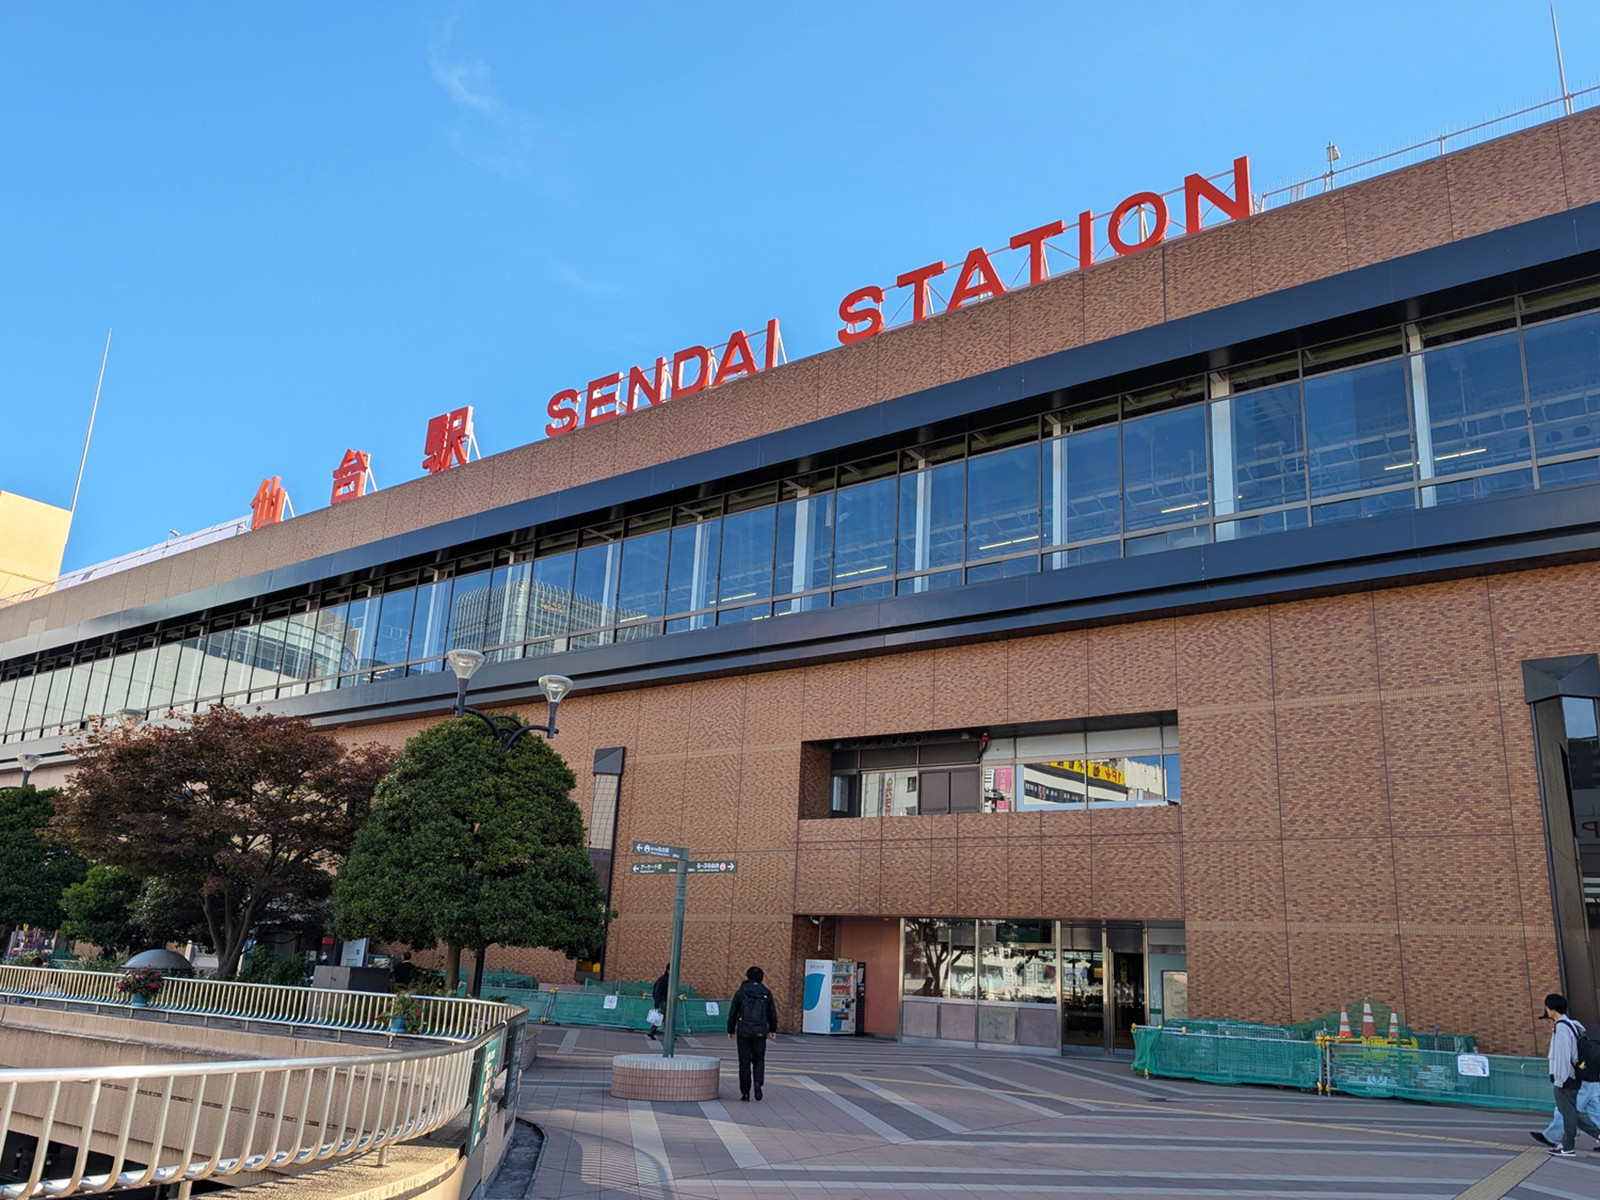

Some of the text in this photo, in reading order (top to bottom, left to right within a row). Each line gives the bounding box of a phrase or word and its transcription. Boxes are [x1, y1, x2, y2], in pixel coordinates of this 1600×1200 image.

[545, 155, 1252, 438] SENDAI STATION
[250, 406, 474, 530] 仙台駅
